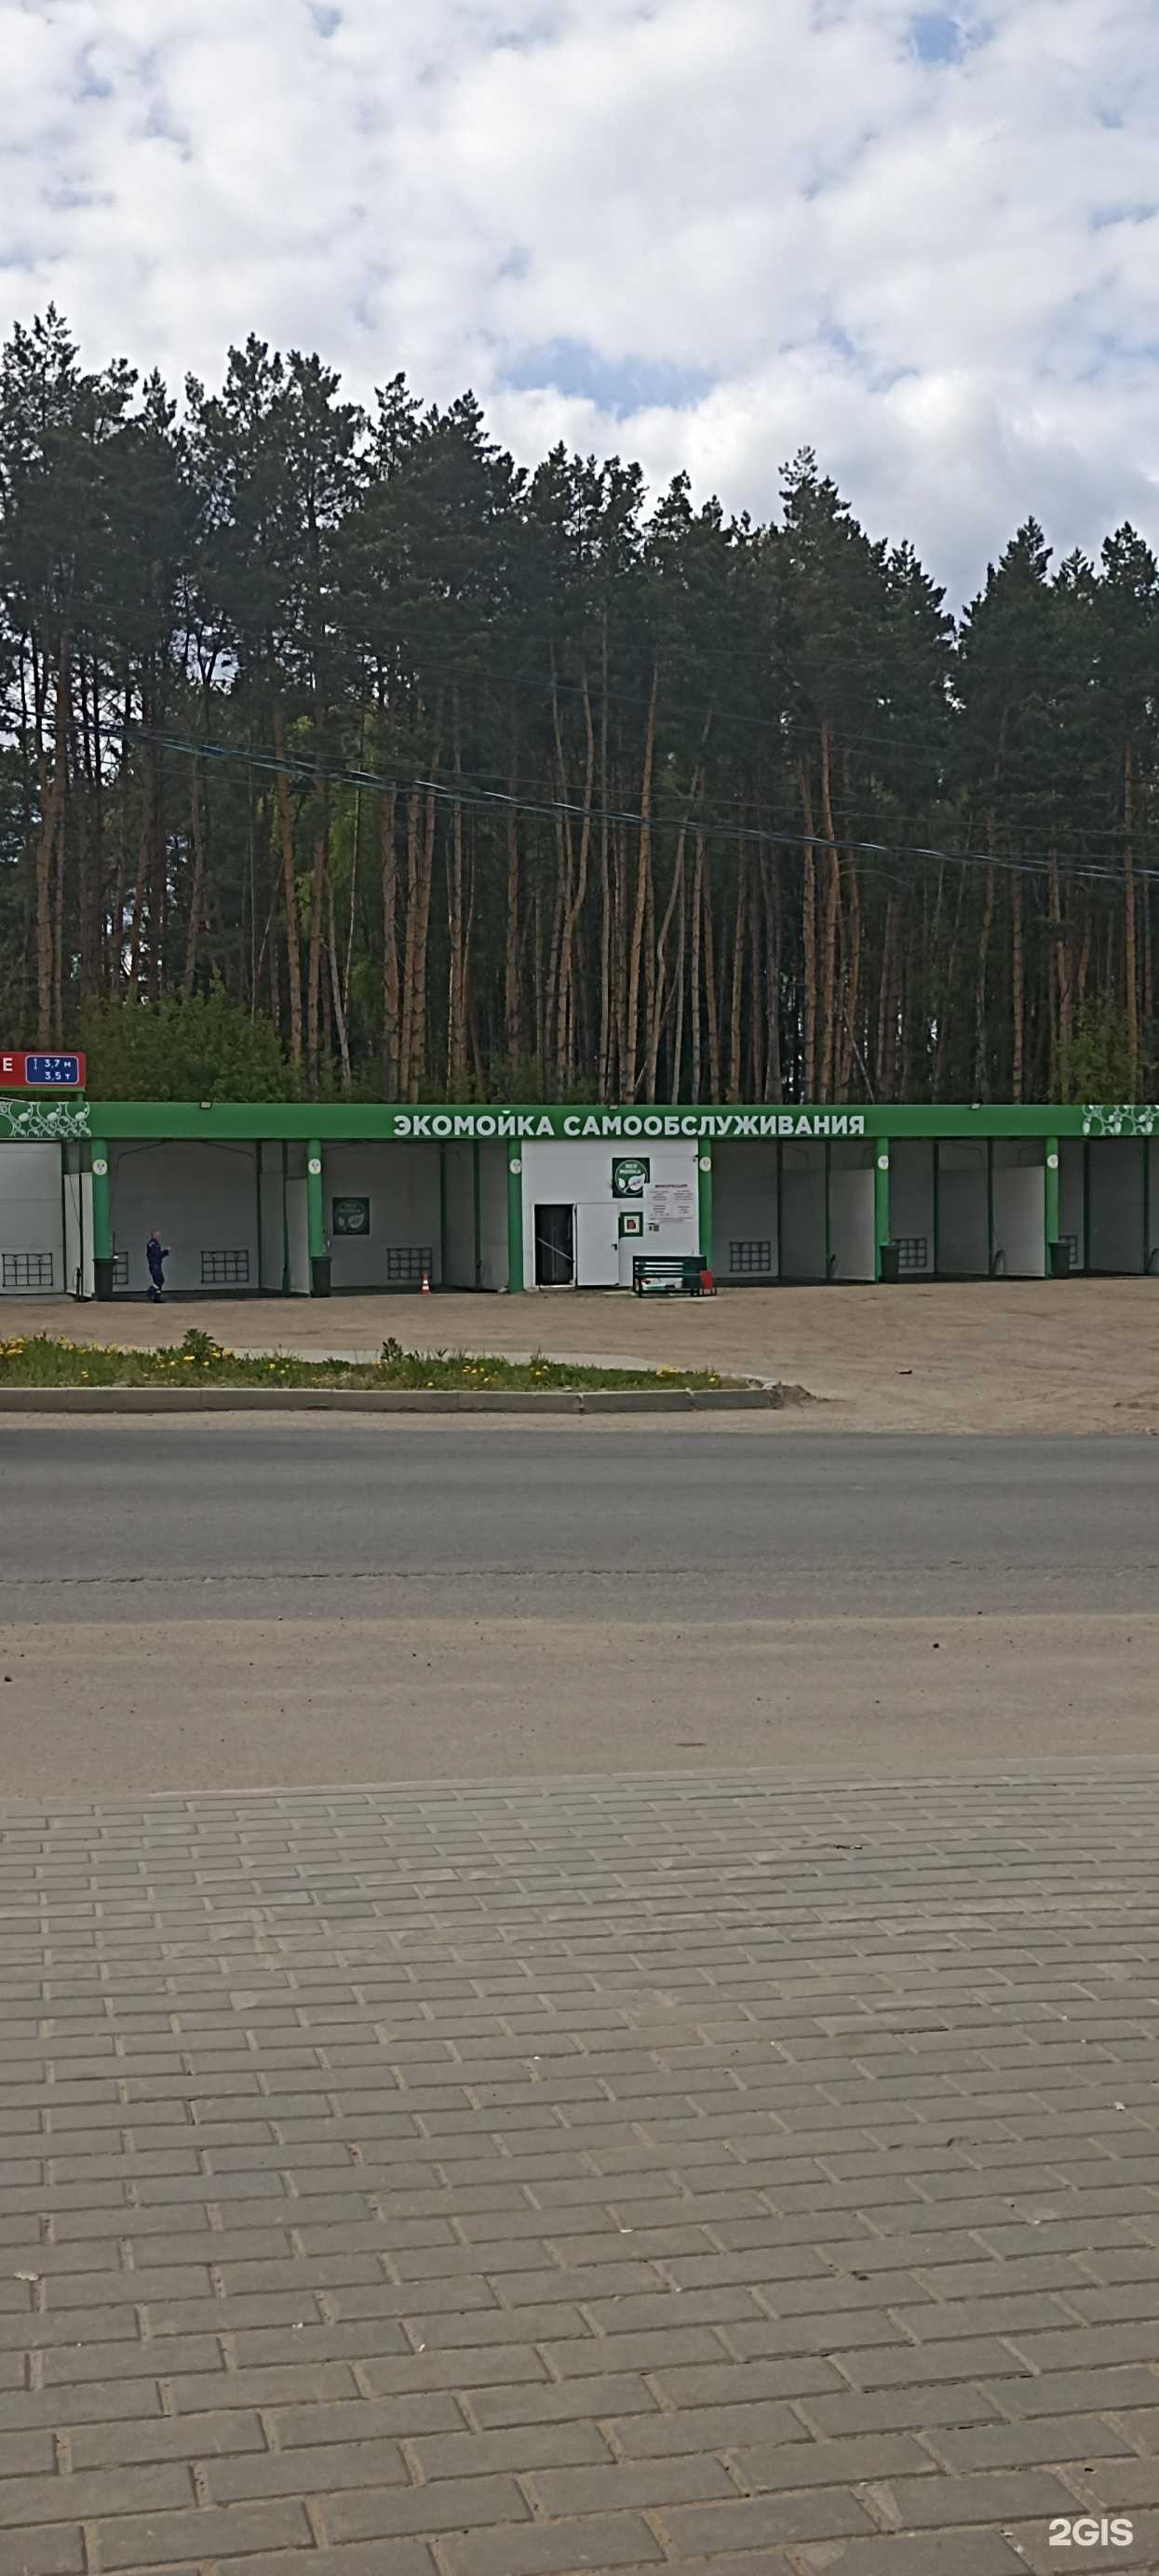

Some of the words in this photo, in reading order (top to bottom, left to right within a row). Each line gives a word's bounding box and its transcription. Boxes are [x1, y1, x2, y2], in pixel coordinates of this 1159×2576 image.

[45, 1059, 61, 1068] 3,7
[45, 1071, 61, 1080] 3,5
[393, 1109, 556, 1136] ЭКОМОЙКА
[562, 1115, 865, 1136] САМООБСЛУЖИВАНИЯ
